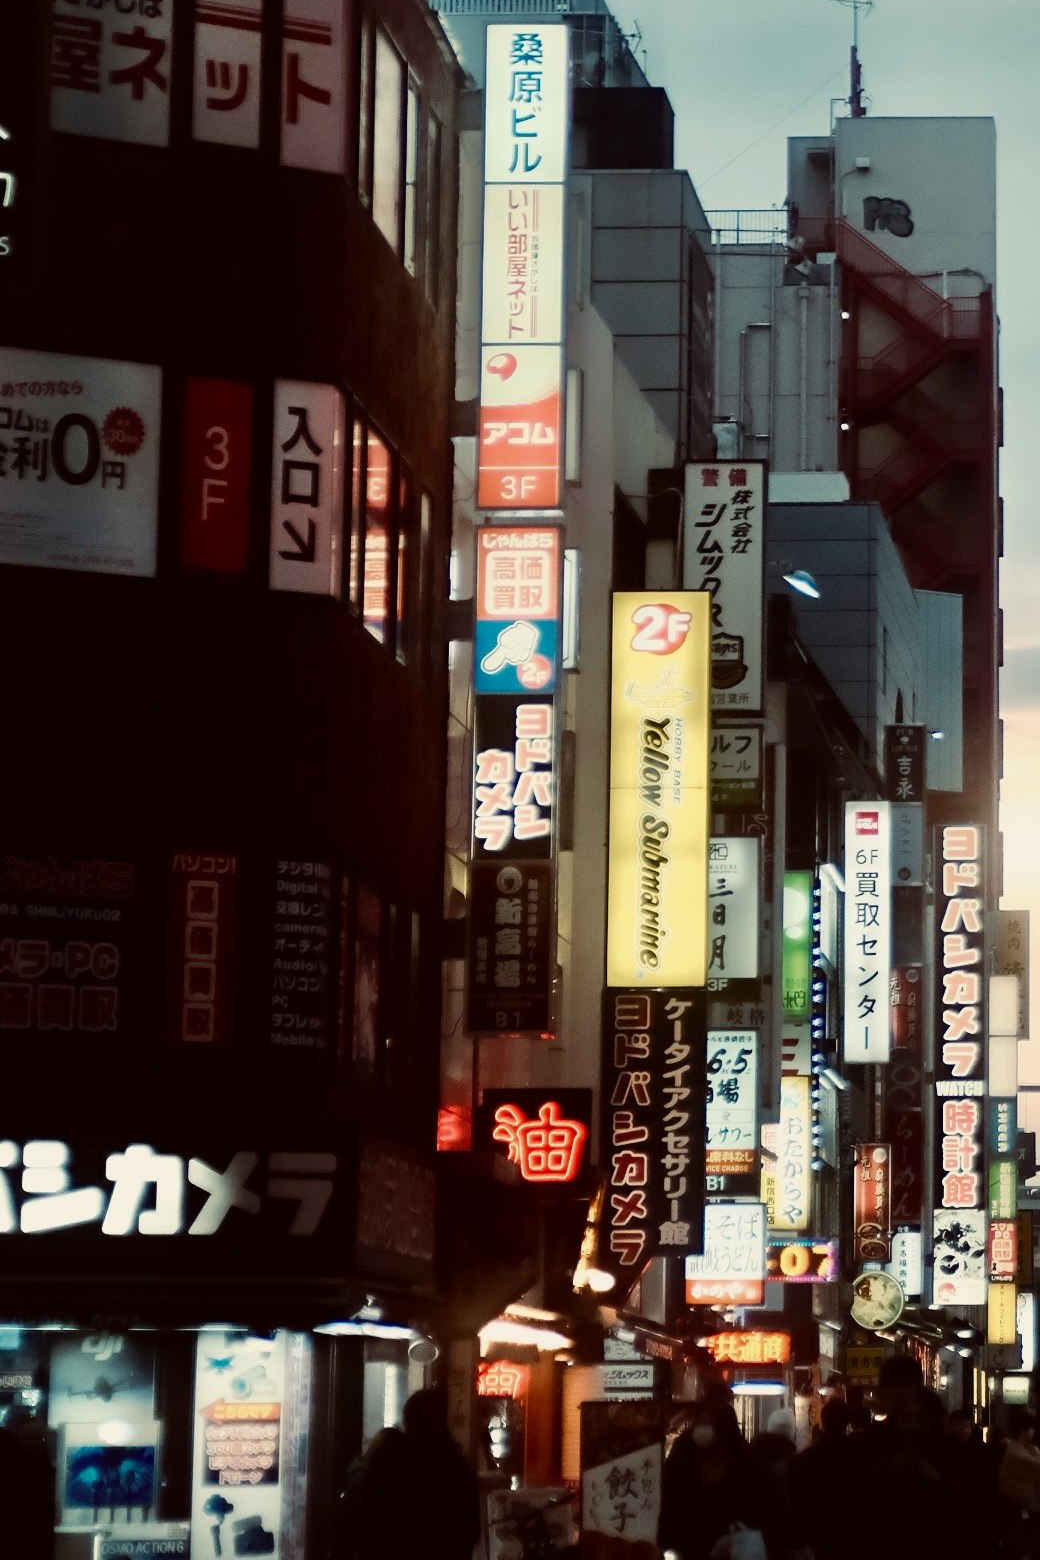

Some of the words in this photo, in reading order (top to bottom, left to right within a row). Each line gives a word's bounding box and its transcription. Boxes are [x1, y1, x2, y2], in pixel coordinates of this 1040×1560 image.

[508, 32, 543, 175] 桑原ビル
[506, 188, 529, 340] いい部屋ネット
[0, 412, 126, 490] 利0円
[281, 406, 322, 508] 入口
[483, 421, 554, 446] アコム
[500, 475, 537, 500] 3F
[701, 468, 747, 488] 警備
[482, 532, 554, 549] じゃんぱら
[730, 490, 755, 555] 株式会社
[493, 556, 544, 581] 高価
[493, 585, 544, 610] 買取
[631, 604, 693, 654] 2F
[520, 662, 548, 686] 2F
[514, 702, 553, 842] ヨドバシ
[641, 715, 671, 809] Yellow
[673, 717, 684, 766] HOBBY
[476, 747, 515, 853] カメラ
[672, 770, 683, 805] BASE
[855, 849, 879, 865] 6F
[638, 814, 672, 972] Submarine
[709, 877, 734, 972] 三日月
[855, 871, 879, 1050] 買取センター
[940, 824, 983, 1079] ヨドバシカメラ
[707, 979, 728, 992] 3F
[936, 1080, 984, 1097] WATCH
[611, 995, 651, 1266] ヨドバシカメラ
[660, 997, 692, 1246] ケータイアクセサリー館
[942, 1099, 980, 1209] 時計館
[706, 1174, 725, 1192] B1
[766, 1177, 776, 1226] 新宿西口店
[782, 1116, 803, 1225] おたからや
[709, 1214, 759, 1240] そば
[605, 1466, 639, 1534] 餃子
